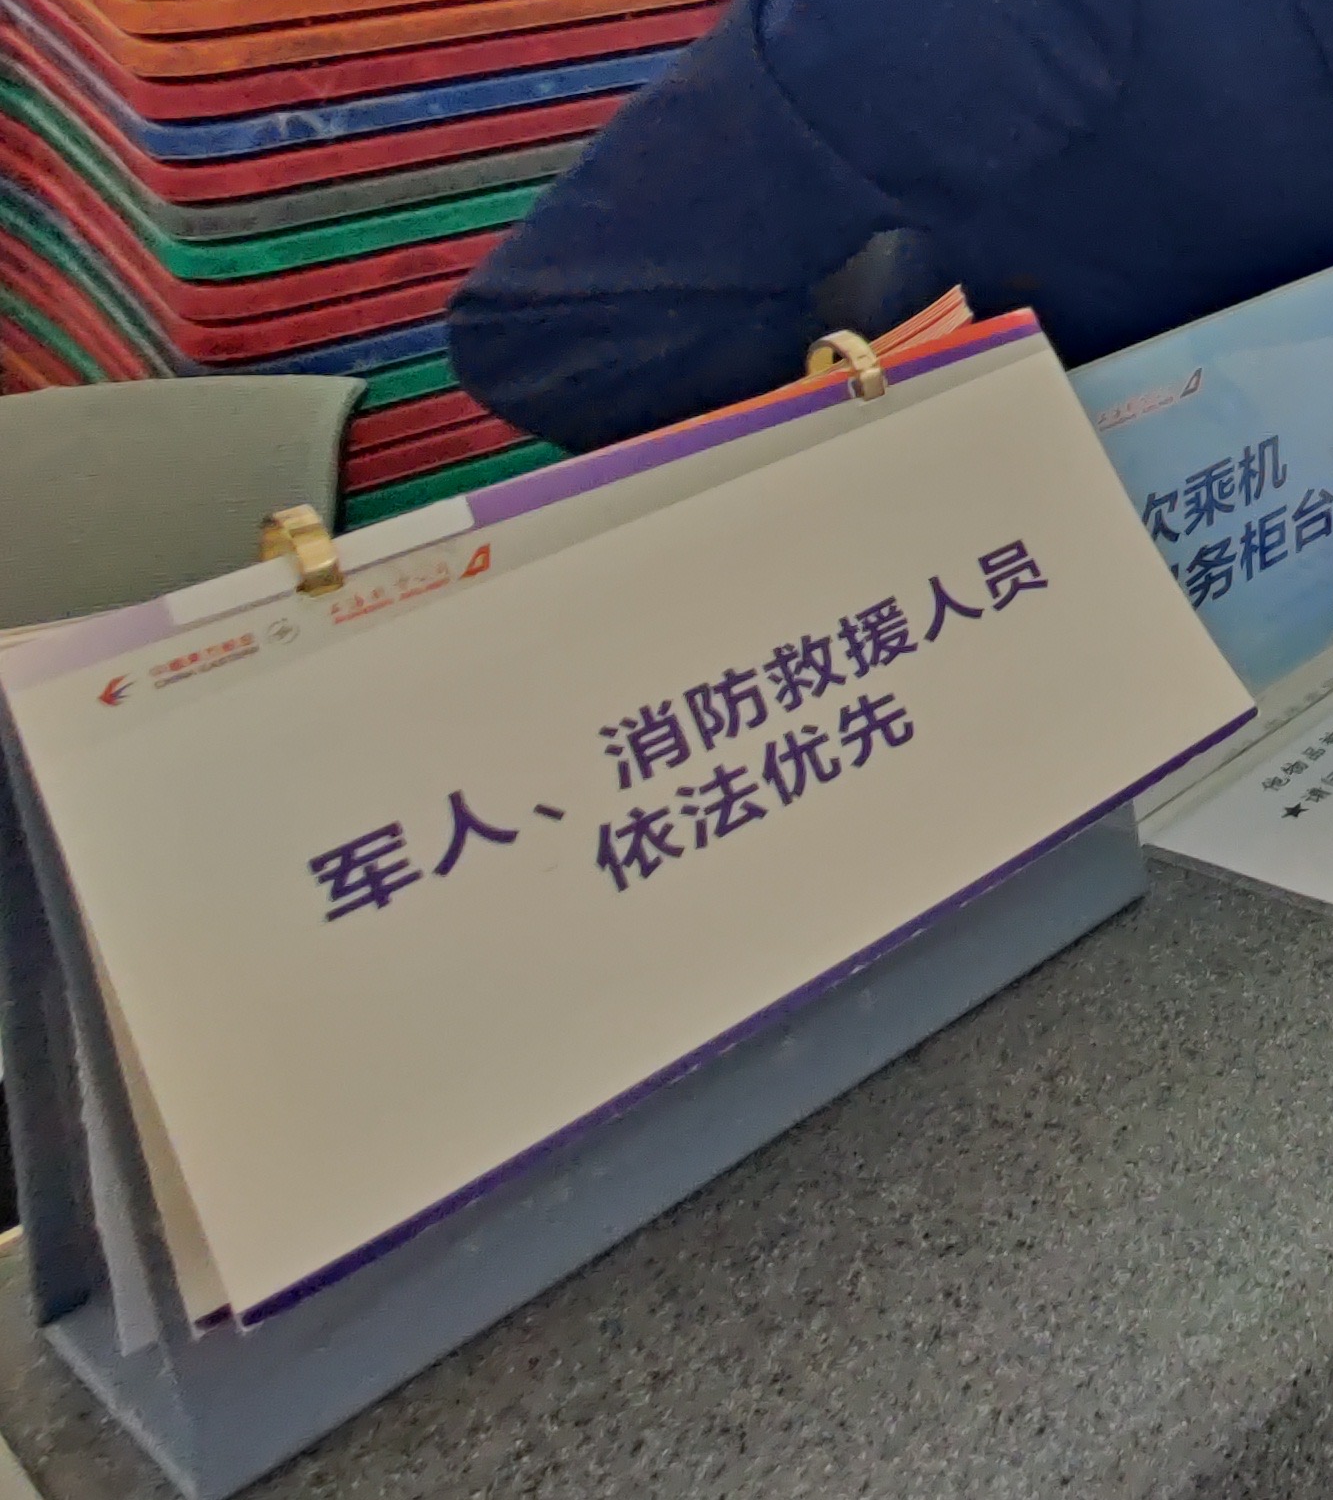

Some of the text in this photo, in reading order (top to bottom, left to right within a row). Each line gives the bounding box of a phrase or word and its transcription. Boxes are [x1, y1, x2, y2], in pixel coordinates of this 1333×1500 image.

[310, 538, 1049, 923] 军人、消防救援人员
[594, 692, 914, 891] 依法优先
